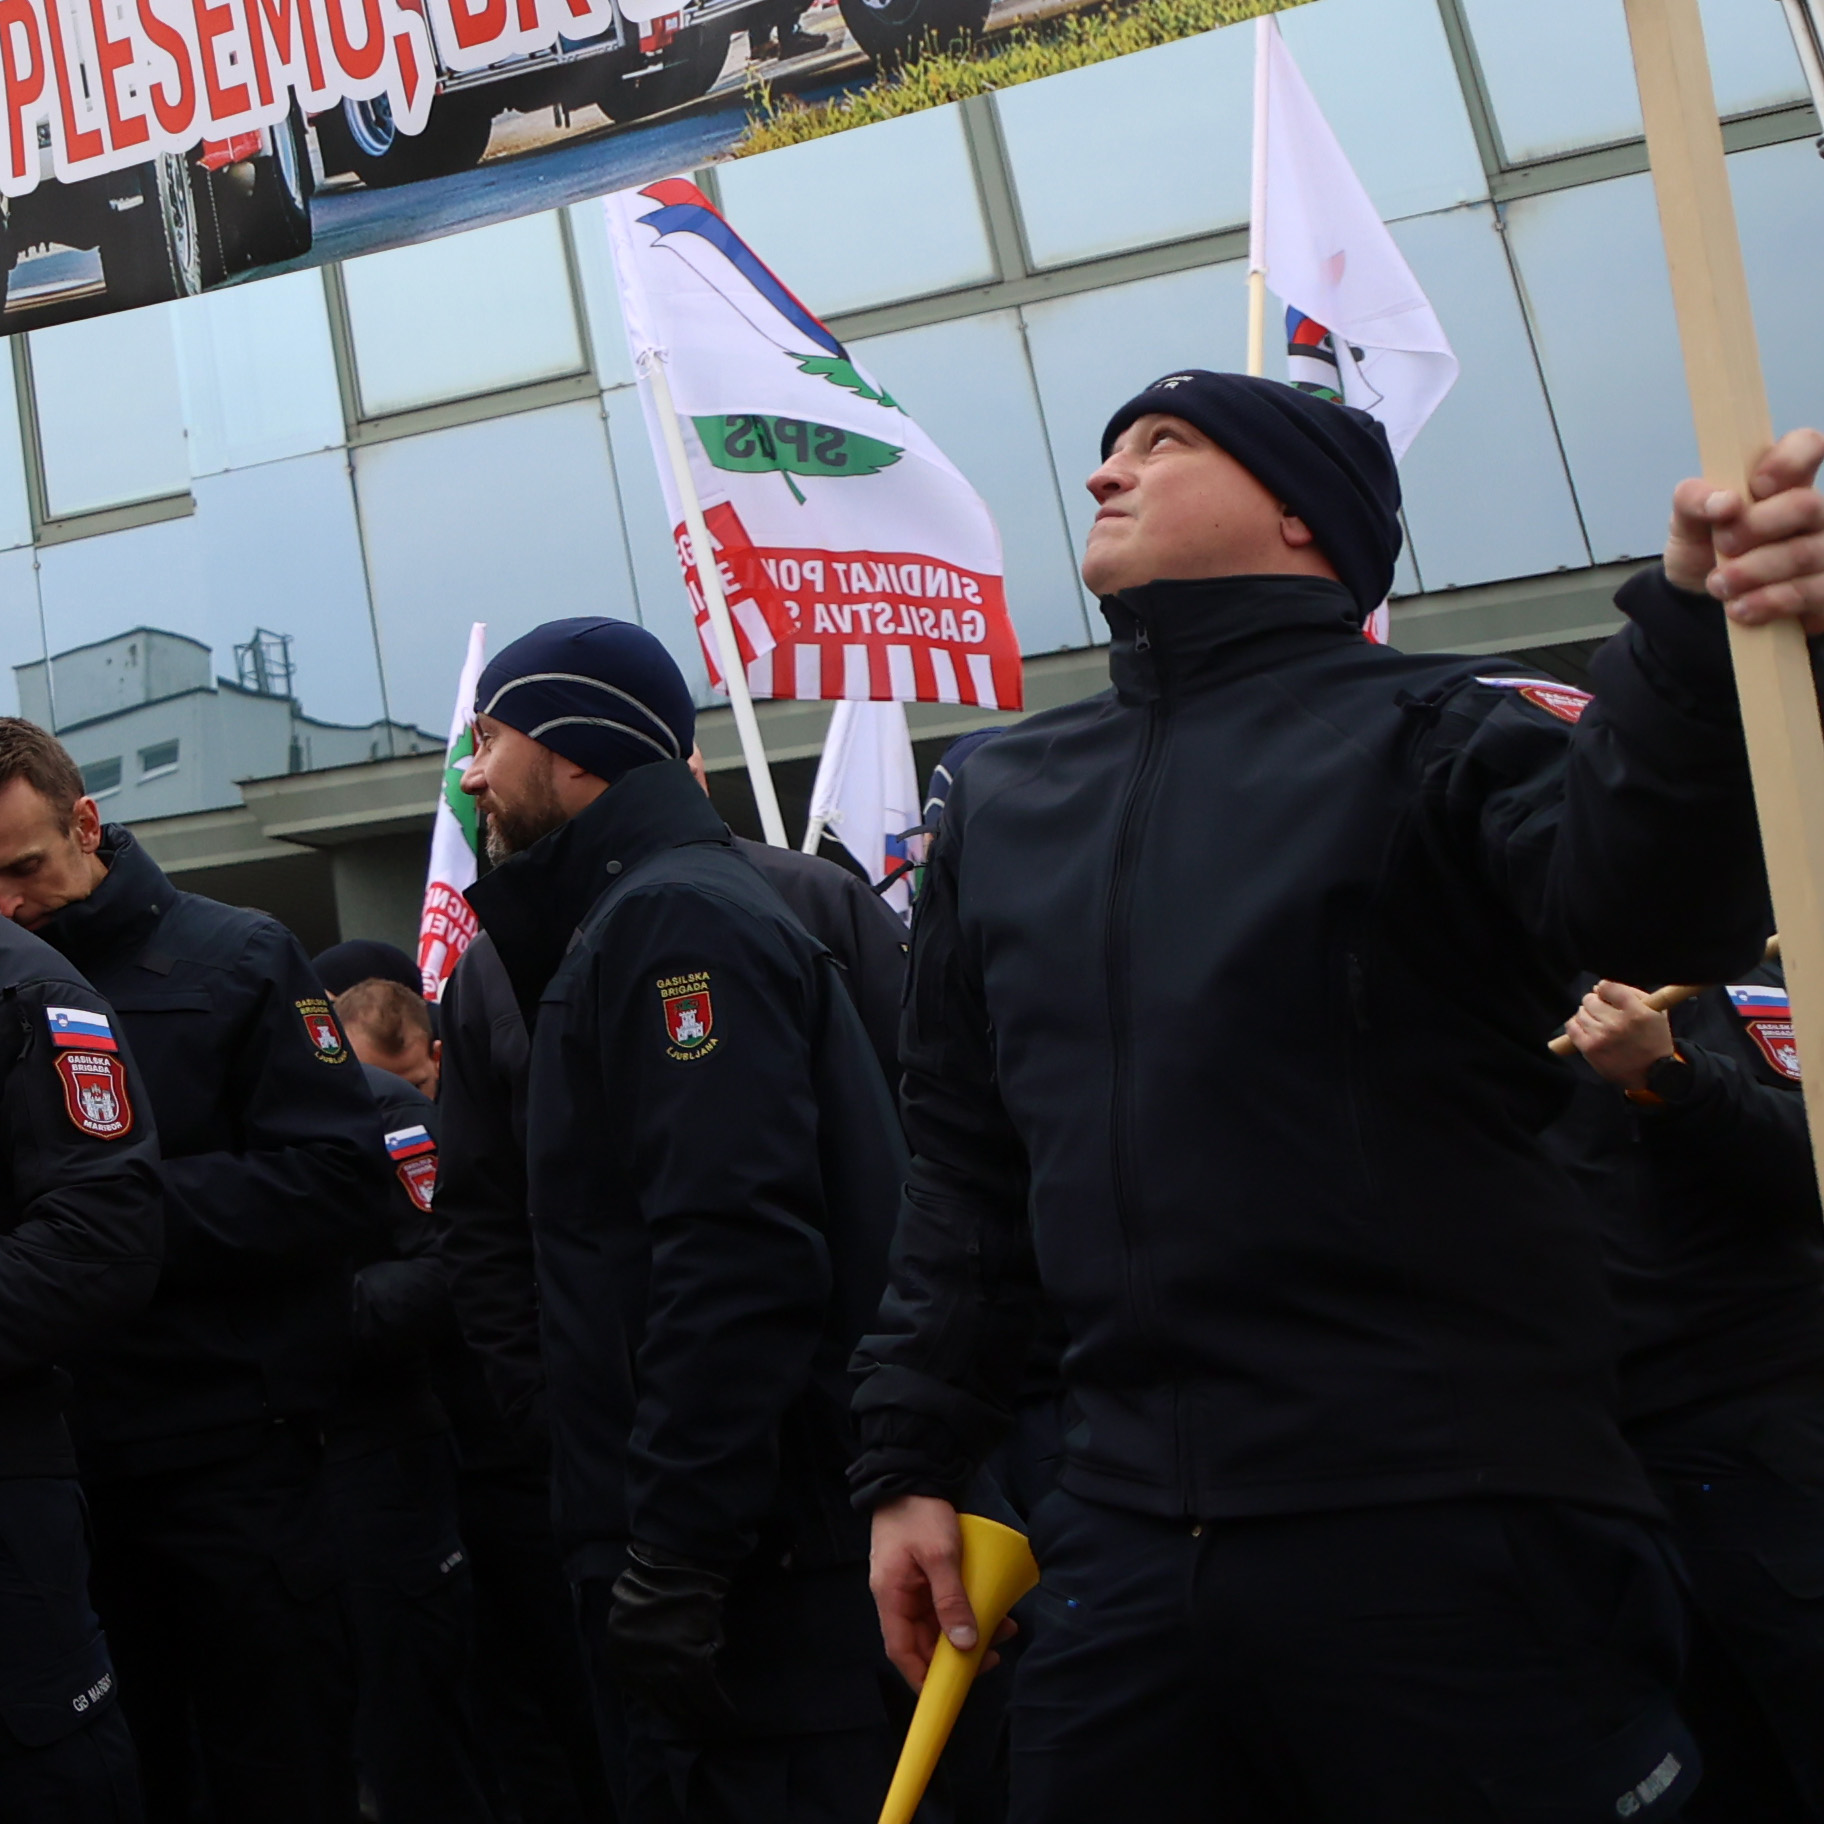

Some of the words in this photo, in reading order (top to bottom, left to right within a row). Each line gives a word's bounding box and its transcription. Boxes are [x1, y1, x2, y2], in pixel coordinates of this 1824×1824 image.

[656, 971, 711, 989] GASILSKA
[660, 981, 709, 998] BRIGADA
[666, 1038, 720, 1061] LJUBLJANA
[67, 1055, 111, 1067] GASILSKA
[71, 1064, 111, 1074] BRIGADA
[83, 1119, 123, 1131] MARIBOR
